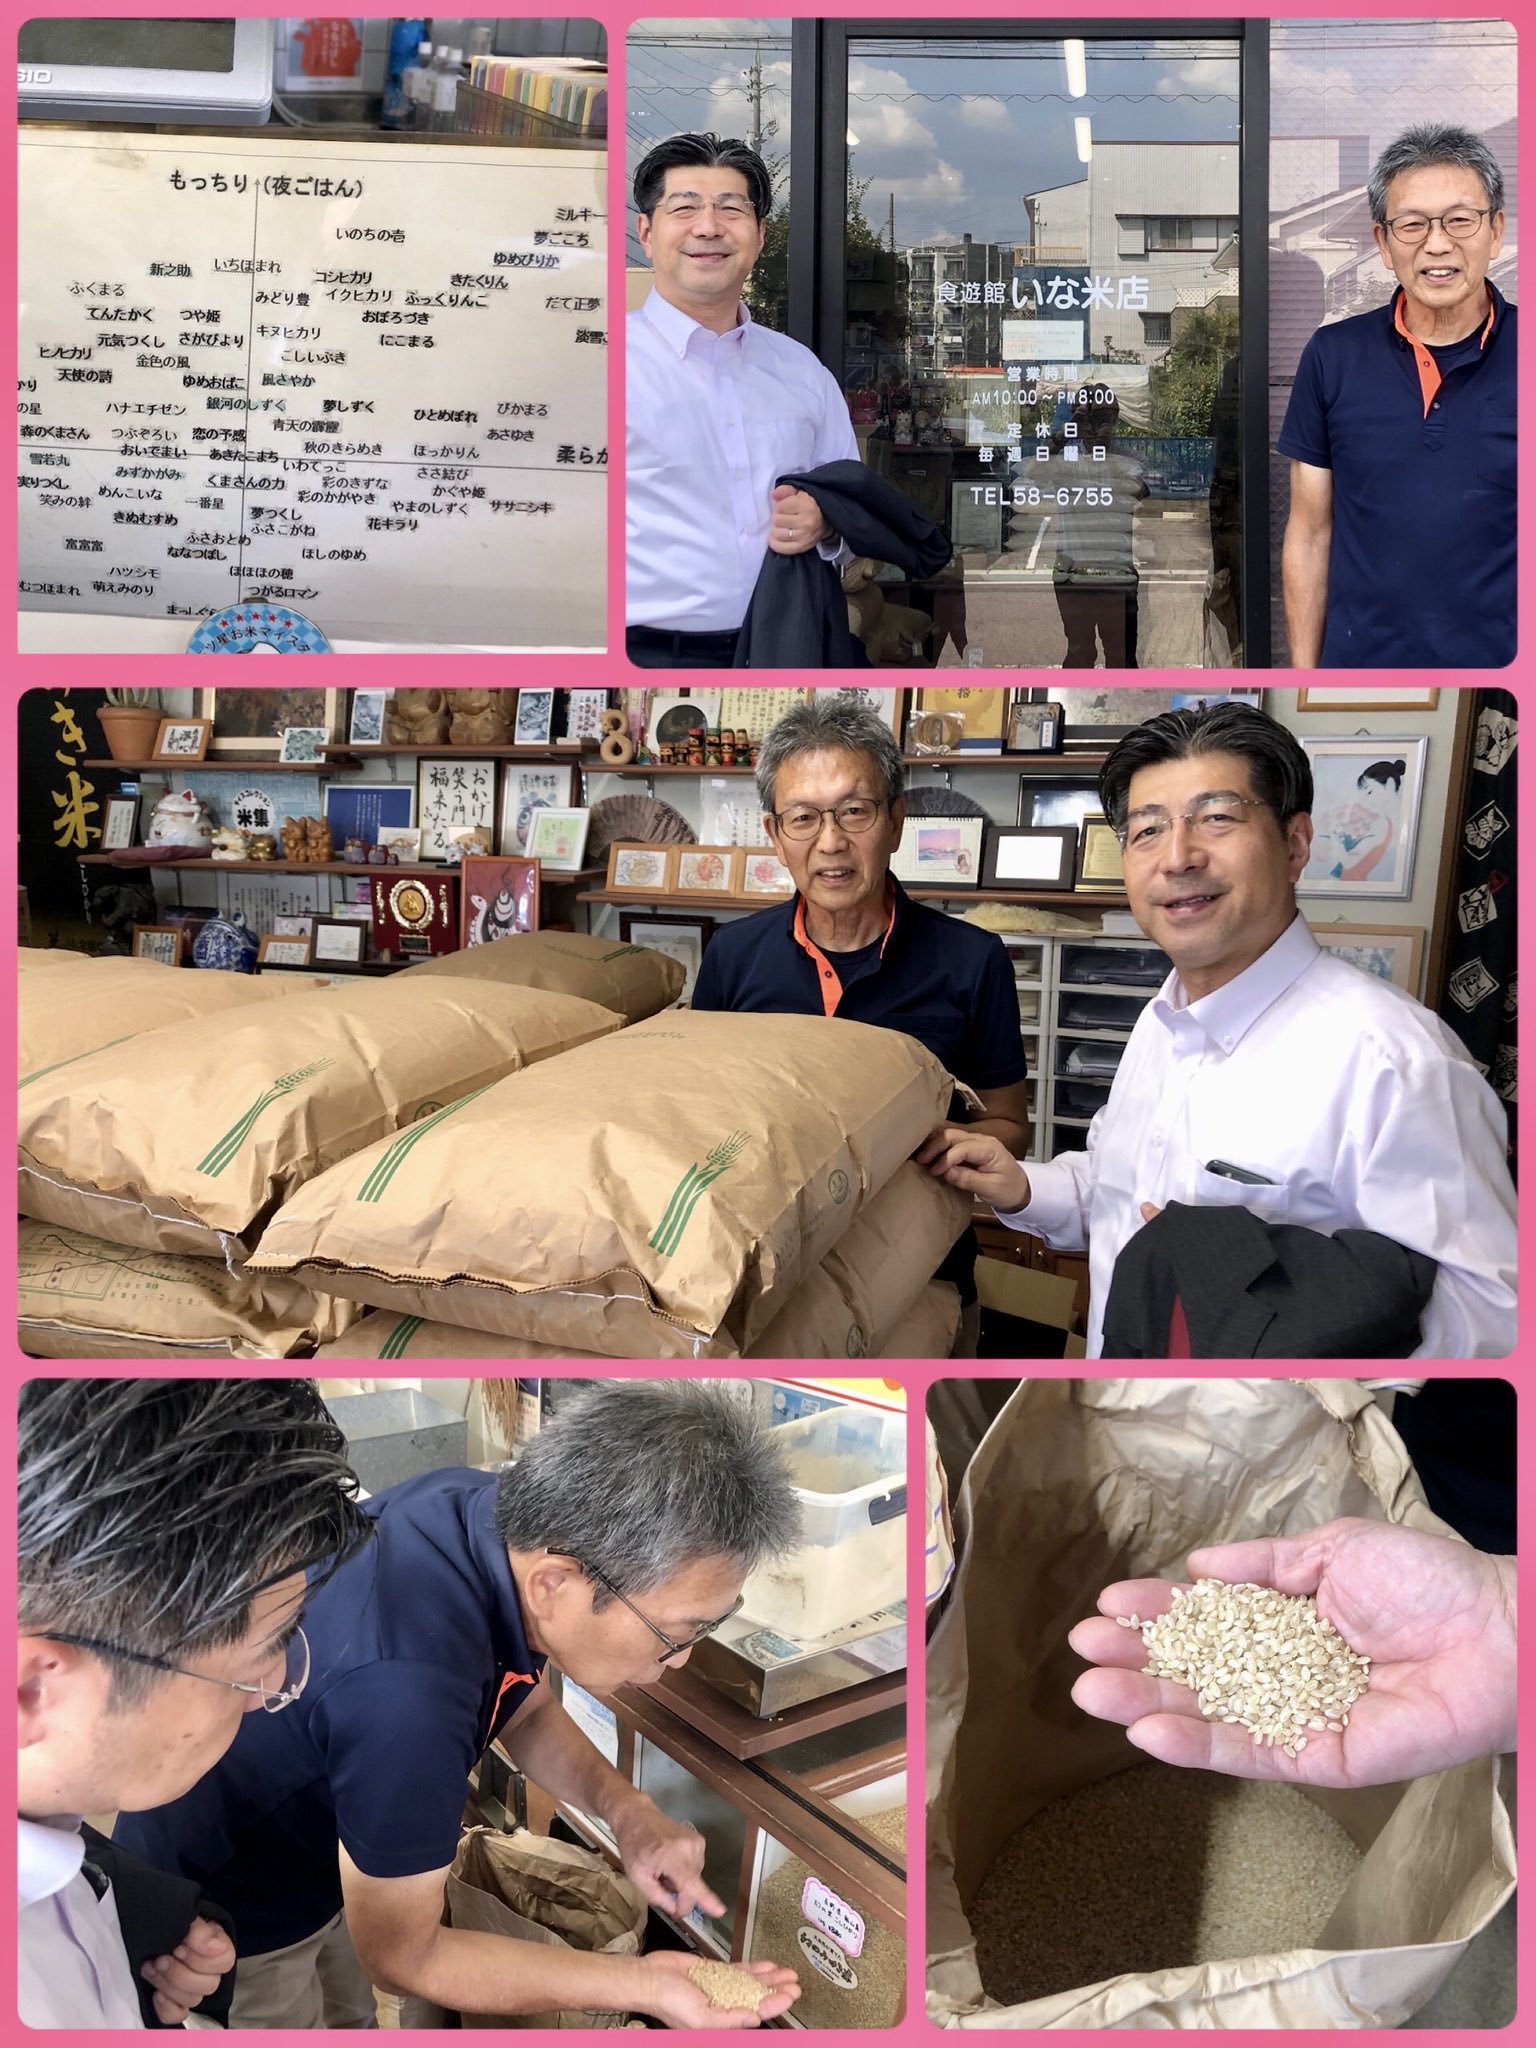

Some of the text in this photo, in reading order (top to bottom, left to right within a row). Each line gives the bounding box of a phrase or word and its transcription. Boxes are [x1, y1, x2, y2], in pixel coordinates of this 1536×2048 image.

[337, 228, 405, 243] いのちの壱
[150, 263, 191, 277] 新之助
[214, 259, 281, 273] いちほまれ
[316, 271, 372, 284] コシヒカリ
[451, 274, 508, 288] きたくりん
[70, 282, 125, 296] ふくまる
[326, 289, 392, 302] イクヒカリ
[937, 276, 1149, 310] 食遊館 いな米店
[255, 292, 309, 306] みどり豊
[406, 292, 488, 307] ふっくりんこ
[545, 297, 600, 310] だて正夢
[86, 308, 153, 321] てんたかく
[180, 309, 220, 323] つや姫
[362, 310, 429, 324] おぼろづき
[256, 326, 320, 339] キヌヒカリ
[98, 334, 165, 348] 元気つくし
[179, 333, 243, 348] さがびより
[380, 335, 434, 348] にこまる
[40, 347, 91, 360] ヒノヒカリ
[281, 351, 346, 364] こしいぶき
[137, 355, 190, 368] 金色の風
[58, 369, 112, 383] 天使の詩
[262, 374, 316, 387] 風さやか
[1007, 366, 1078, 382] 営業時間
[183, 375, 244, 389] ゆめおばこ
[107, 403, 186, 416] ハナエチゼン
[207, 397, 285, 412] 銀河のしずく
[323, 400, 374, 413] 夢しずく
[414, 410, 477, 423] ひとめぼれ
[21, 425, 89, 440] 森のくまさん
[112, 427, 176, 441] つぶぞろい
[193, 428, 246, 442] 恋の予感
[487, 429, 534, 442] あさゆき
[1008, 422, 1078, 438] 定休日
[121, 444, 186, 458] おいでまい
[304, 441, 382, 456] 秋のきらめき
[414, 446, 480, 459] ほっかりん
[979, 446, 1106, 462] 毎週日曜日
[29, 453, 70, 467] 雪若丸
[210, 449, 278, 463] あきたこまち
[116, 467, 181, 480] みずかがみ
[284, 461, 346, 472] いわてっこ
[417, 468, 468, 480] ささ結び
[18, 477, 69, 489] 実りつくし
[208, 476, 285, 490] くまさんの力
[323, 477, 388, 489] 彩のきずな
[99, 487, 162, 501] めんこいな
[298, 490, 376, 504] 彩のかがやき
[433, 486, 485, 498] かぐや姫
[971, 487, 1113, 506] TEL58-6755
[40, 495, 91, 508] 笑みの絆
[185, 498, 224, 509] 一番星
[392, 502, 468, 515] やまのしずく
[490, 501, 551, 513] ササニシキ
[114, 512, 177, 526] きぬむすめ
[251, 507, 302, 520] 夢つくし
[251, 525, 315, 537] ふさこがね
[367, 518, 417, 531] 花キラリ
[66, 538, 103, 552] 富富富
[187, 533, 251, 546] ふさおとめ
[302, 548, 366, 561] ほしのゆめ
[110, 566, 159, 579] ハツシモ
[230, 566, 293, 580] ほほほの穂
[18, 581, 80, 596] むつほまれ
[93, 581, 154, 596] 萌えみのり
[248, 585, 318, 599] つがるロマン
[430, 767, 449, 848] 福来たる
[237, 808, 270, 828] 米集
